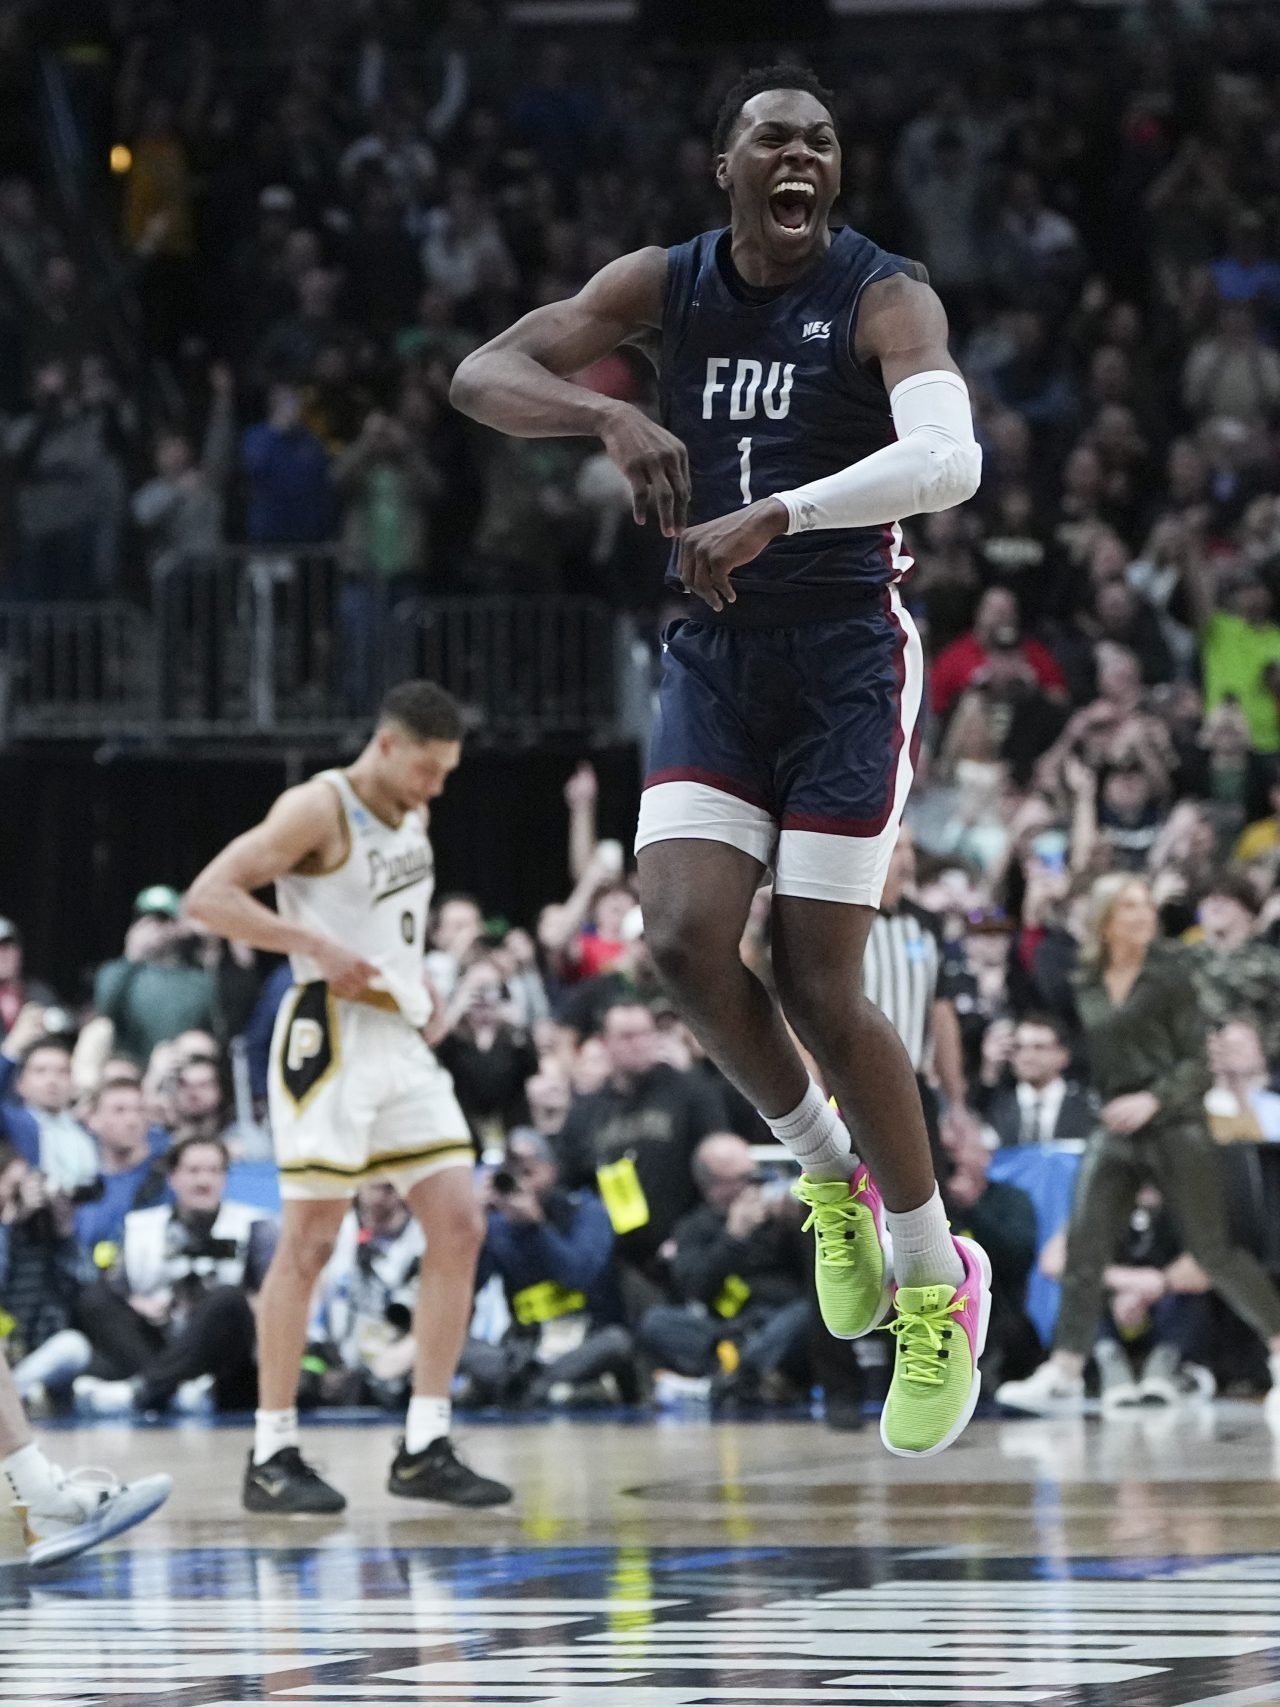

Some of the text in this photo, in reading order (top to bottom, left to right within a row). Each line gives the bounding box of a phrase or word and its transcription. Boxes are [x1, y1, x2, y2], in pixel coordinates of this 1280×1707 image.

[701, 357, 796, 421] FDU
[736, 436, 753, 505] 1
[401, 910, 415, 945] 0
[287, 1018, 323, 1071] P
